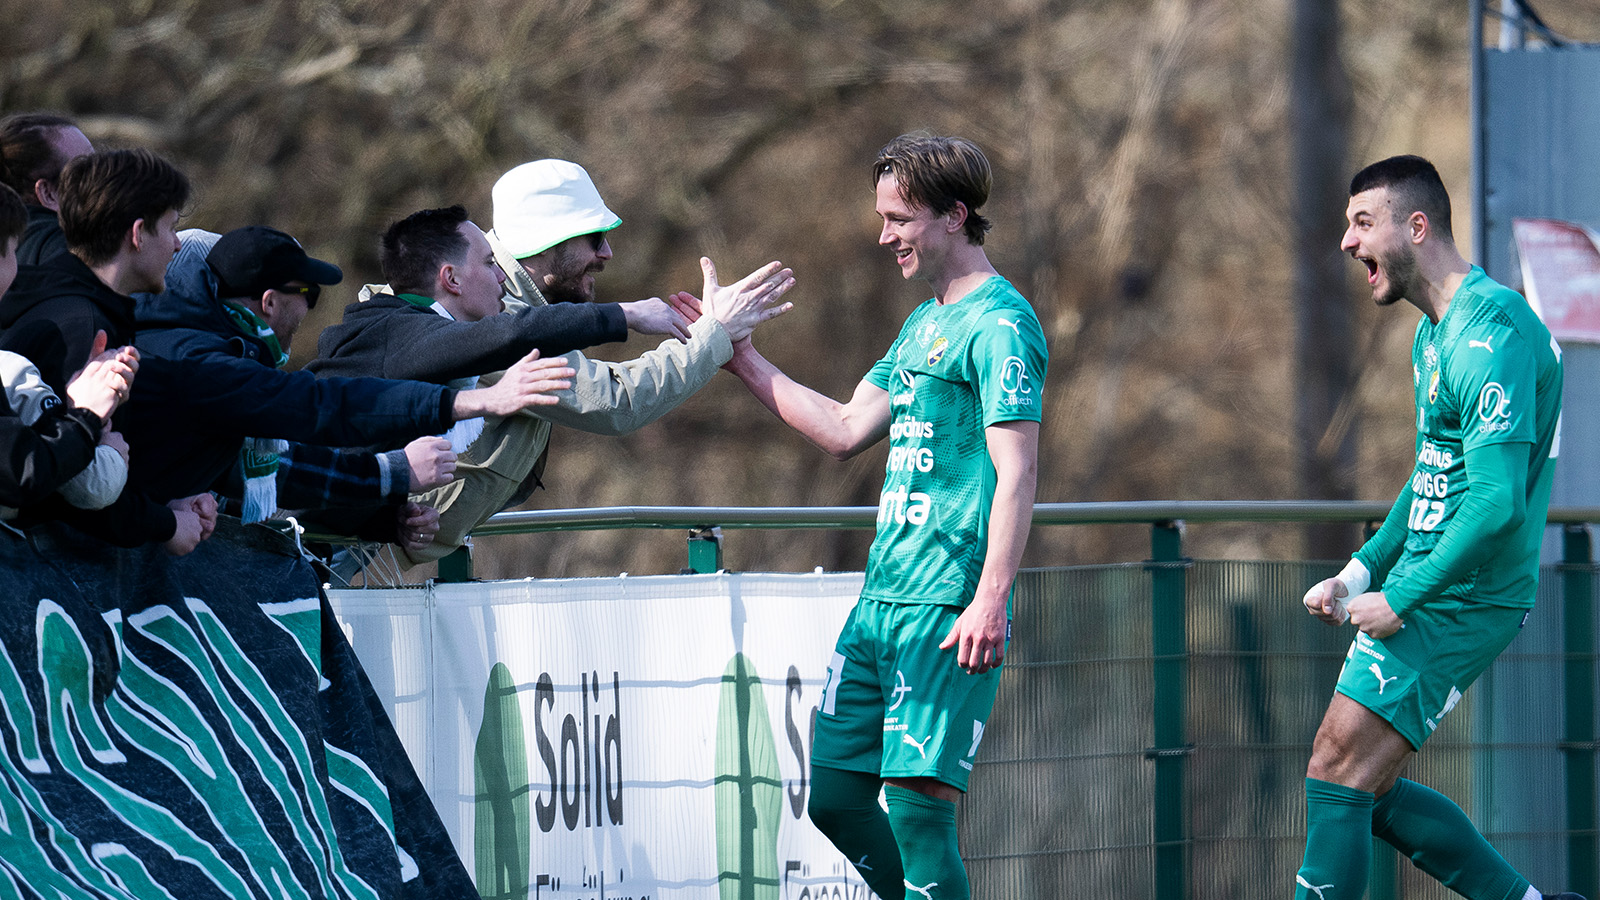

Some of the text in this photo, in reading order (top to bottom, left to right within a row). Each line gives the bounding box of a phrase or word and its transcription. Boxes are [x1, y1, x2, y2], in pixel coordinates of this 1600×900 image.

[886, 446, 934, 473] BYGG
[876, 484, 932, 526] nta
[534, 669, 624, 833] Solid
